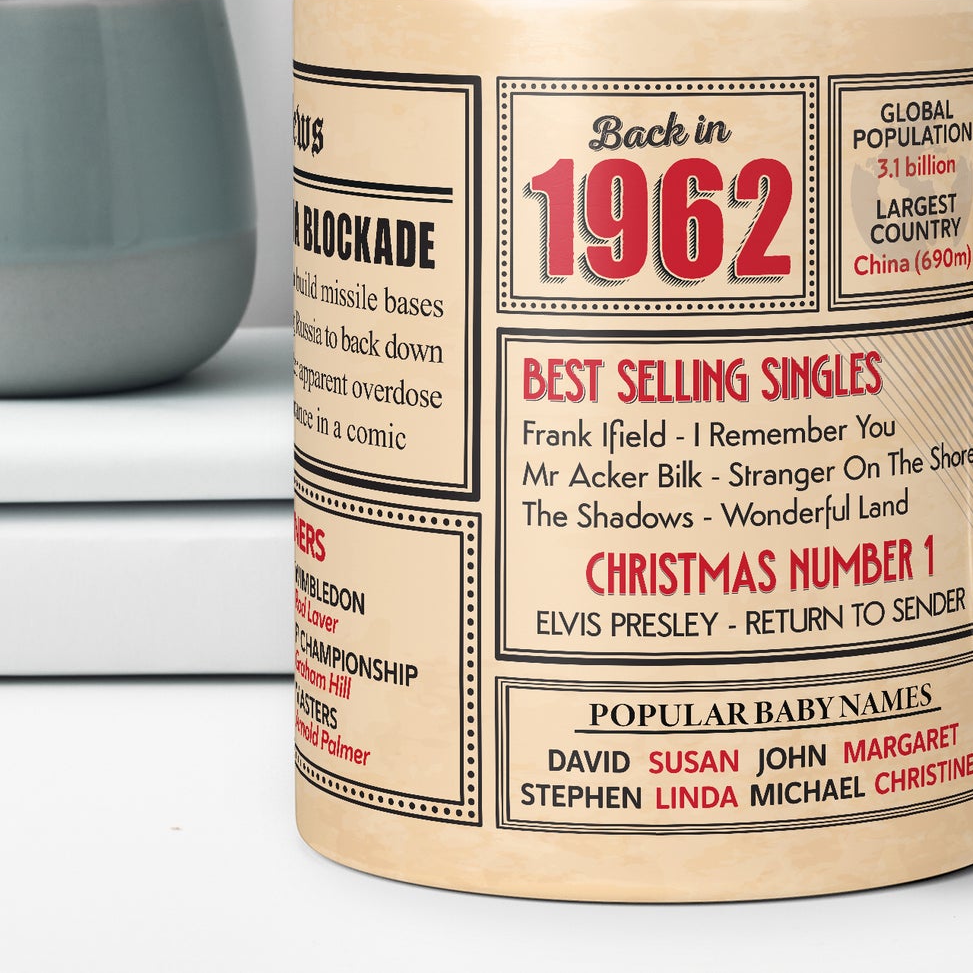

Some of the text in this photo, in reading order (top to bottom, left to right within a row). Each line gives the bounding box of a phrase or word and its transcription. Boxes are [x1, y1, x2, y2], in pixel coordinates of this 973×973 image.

[589, 111, 731, 151] Back in
[881, 100, 953, 123] GLOBAL
[853, 122, 972, 149] POPULATION
[878, 154, 955, 178] 3.1 billion
[523, 158, 792, 287] 1962
[877, 194, 957, 219] LARGEST
[304, 205, 435, 269] BLOCKADE
[871, 217, 961, 244] COUNTRY
[854, 244, 971, 275] China (690m)
[296, 267, 317, 299] build
[321, 280, 378, 311] missile
[384, 287, 443, 317] bases
[296, 310, 322, 345] Russia
[325, 326, 337, 349] to
[341, 326, 380, 357] back
[385, 333, 443, 363] down
[299, 364, 348, 395] apparent
[352, 379, 443, 408] overdose
[523, 350, 883, 404] BEST SELLING SINGLES
[317, 408, 329, 436] in
[334, 421, 341, 439] a
[347, 423, 406, 450] comic
[523, 420, 592, 447] Frank
[602, 419, 666, 454] Ifield
[695, 423, 699, 447] I
[710, 416, 847, 447] Remember
[855, 414, 896, 439] You
[523, 462, 559, 487] Mr
[568, 462, 648, 488] Acker
[658, 461, 702, 488] Bilk
[728, 456, 836, 491] Stranger
[844, 455, 880, 482] On
[888, 447, 923, 475] The
[523, 499, 567, 528] The
[577, 503, 694, 529] Shadows
[720, 494, 850, 529] Wonderful
[859, 488, 909, 519] Land
[586, 535, 934, 597] CHRISTMAS NUMBER 1
[308, 601, 338, 633] Laver
[536, 611, 601, 636] ELVIS
[611, 612, 719, 637] PRESLEY
[745, 605, 844, 636] RETURN
[852, 601, 885, 627] TO
[892, 587, 966, 623] SENDER
[301, 630, 418, 686] CHAMPIONSHIP
[329, 673, 351, 699] Hill
[589, 683, 933, 727] POPULAR BABY NAMES
[321, 730, 370, 765] Palmer
[548, 723, 959, 777] DAVID SUSAN JOHN MARGARET
[521, 784, 641, 809] STEPHEN
[655, 786, 738, 809] LINDA
[750, 776, 866, 806] MICHAEL
